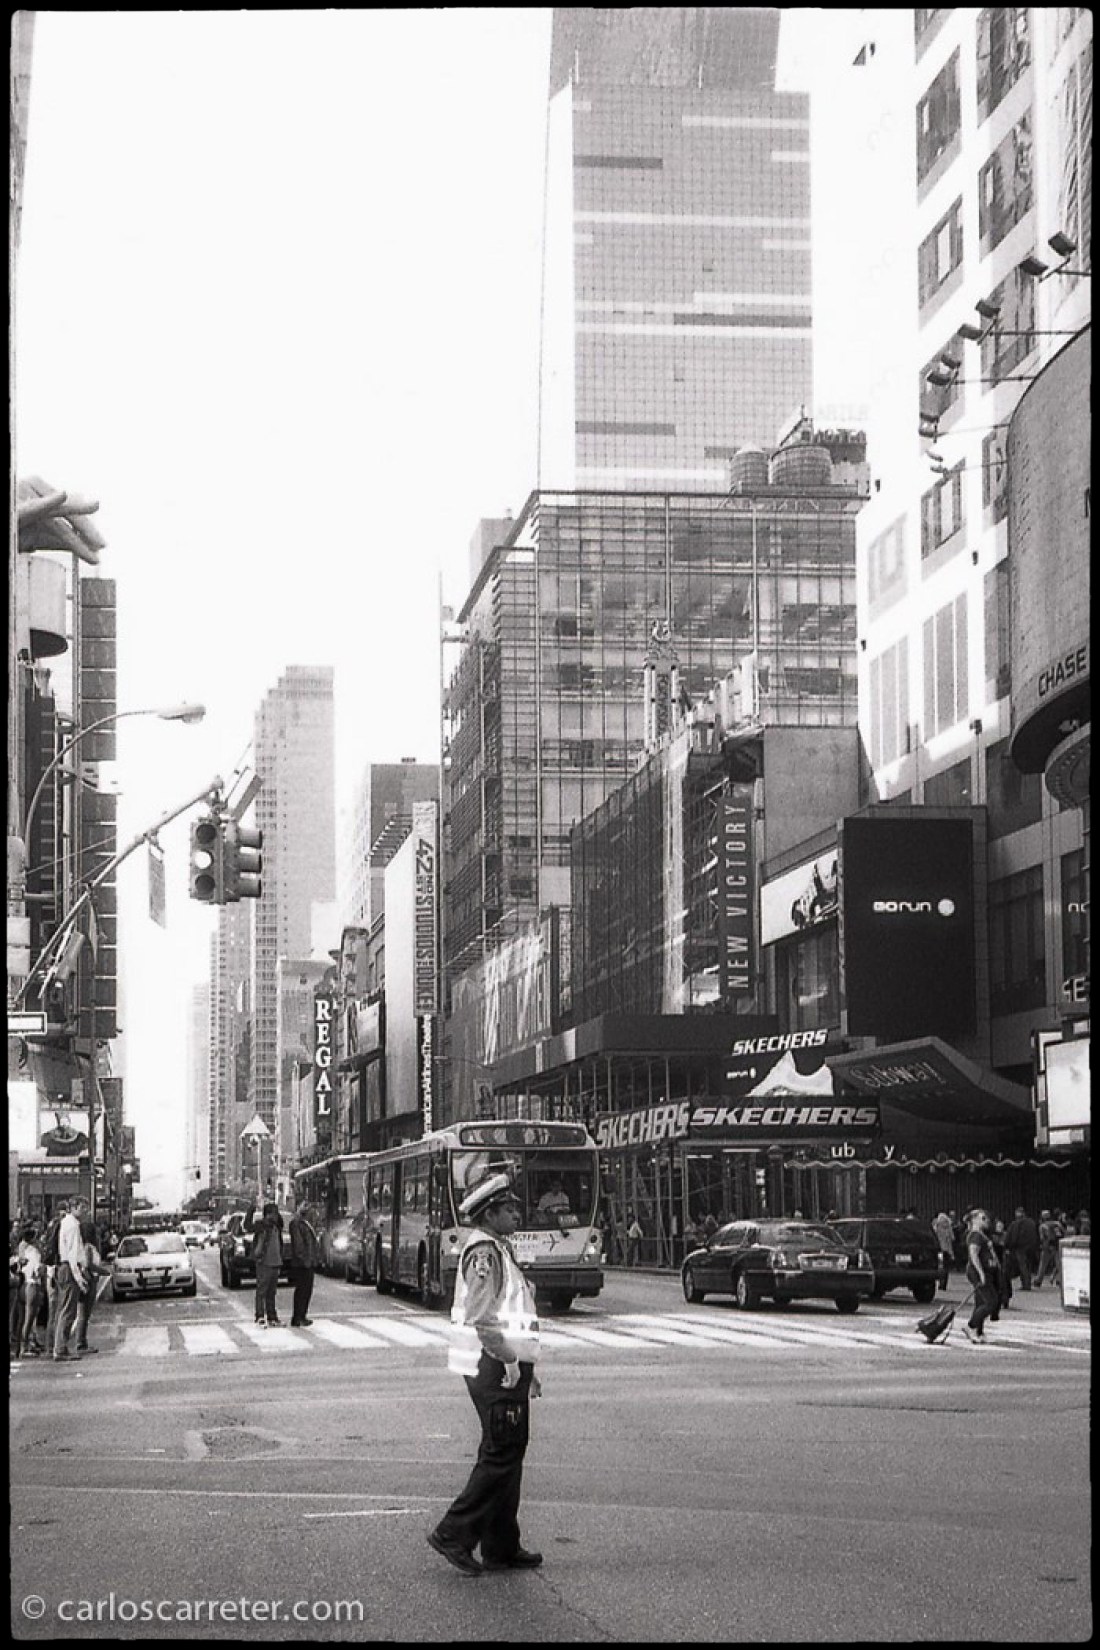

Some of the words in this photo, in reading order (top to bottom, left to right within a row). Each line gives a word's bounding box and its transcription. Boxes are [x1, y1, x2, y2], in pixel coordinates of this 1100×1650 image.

[1038, 645, 1087, 697] CHASE
[725, 804, 747, 917] VICTORY
[727, 936, 749, 988] NEW
[315, 999, 332, 1115] REGAL
[731, 1028, 829, 1056] SKECHERS
[596, 1101, 690, 1149] SKECHERS
[690, 1106, 878, 1126] SKECHERS
